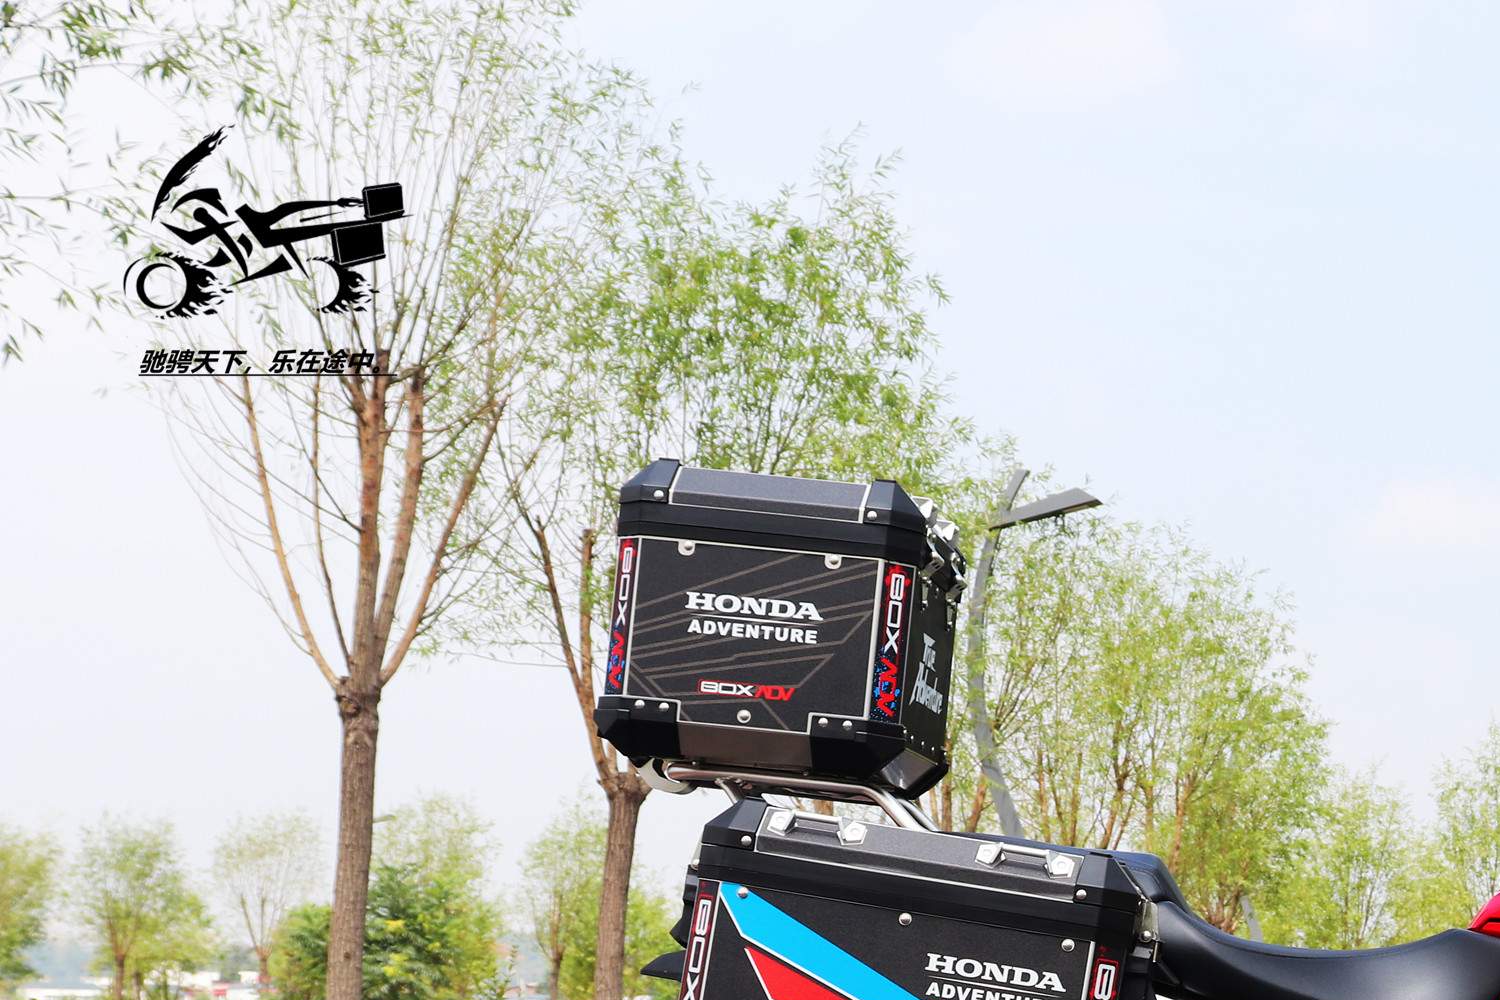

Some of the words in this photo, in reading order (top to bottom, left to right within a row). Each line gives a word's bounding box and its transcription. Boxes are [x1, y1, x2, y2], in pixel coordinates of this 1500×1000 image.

[684, 591, 823, 621] HONDA
[883, 572, 905, 655] BOX
[687, 619, 818, 644] ADVENTURE
[924, 952, 1066, 993] HONDA
